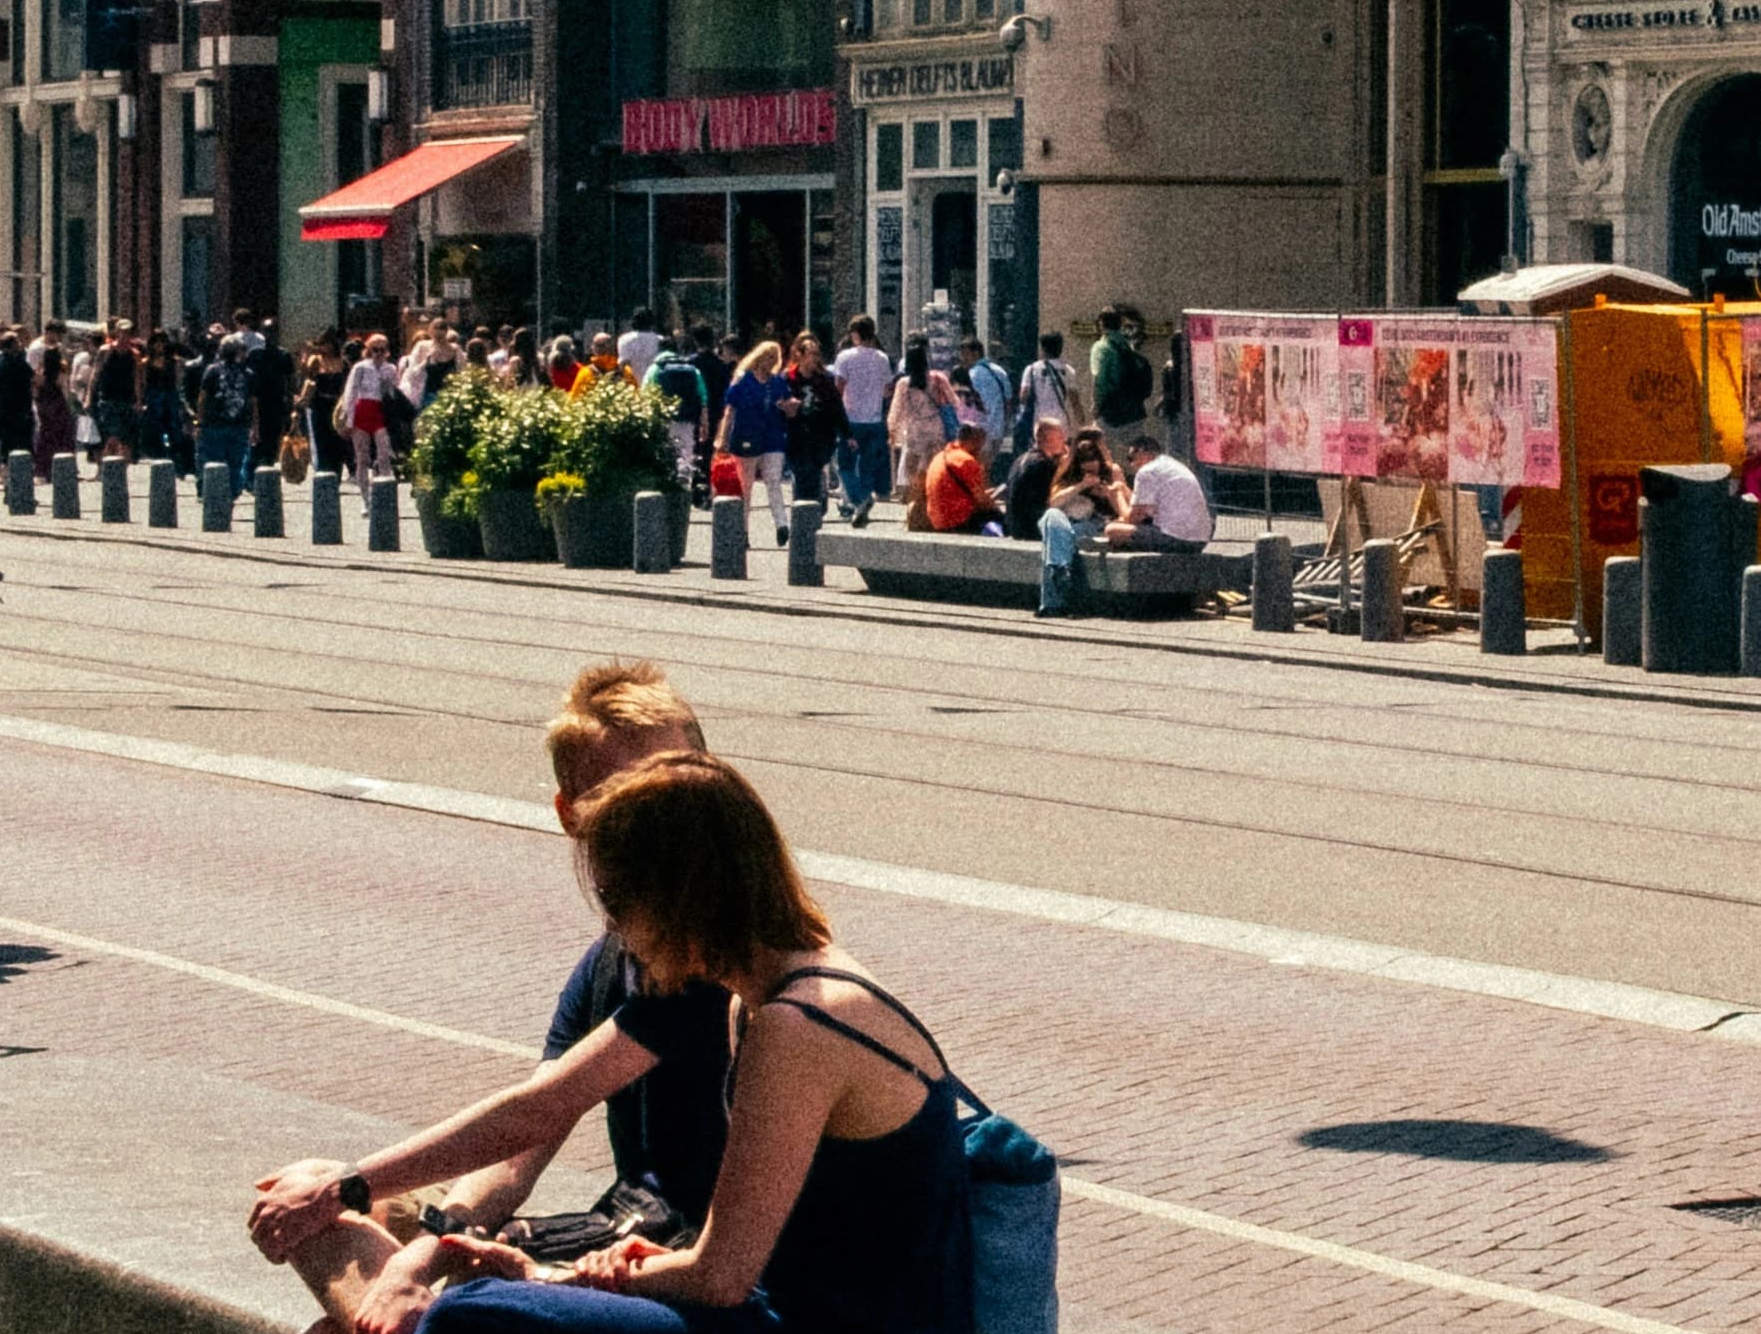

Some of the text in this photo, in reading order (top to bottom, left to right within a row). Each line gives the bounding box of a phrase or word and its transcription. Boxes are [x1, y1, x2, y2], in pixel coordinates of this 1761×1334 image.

[622, 88, 838, 154] BODY WORLDS
[1702, 203, 1728, 236] Old
